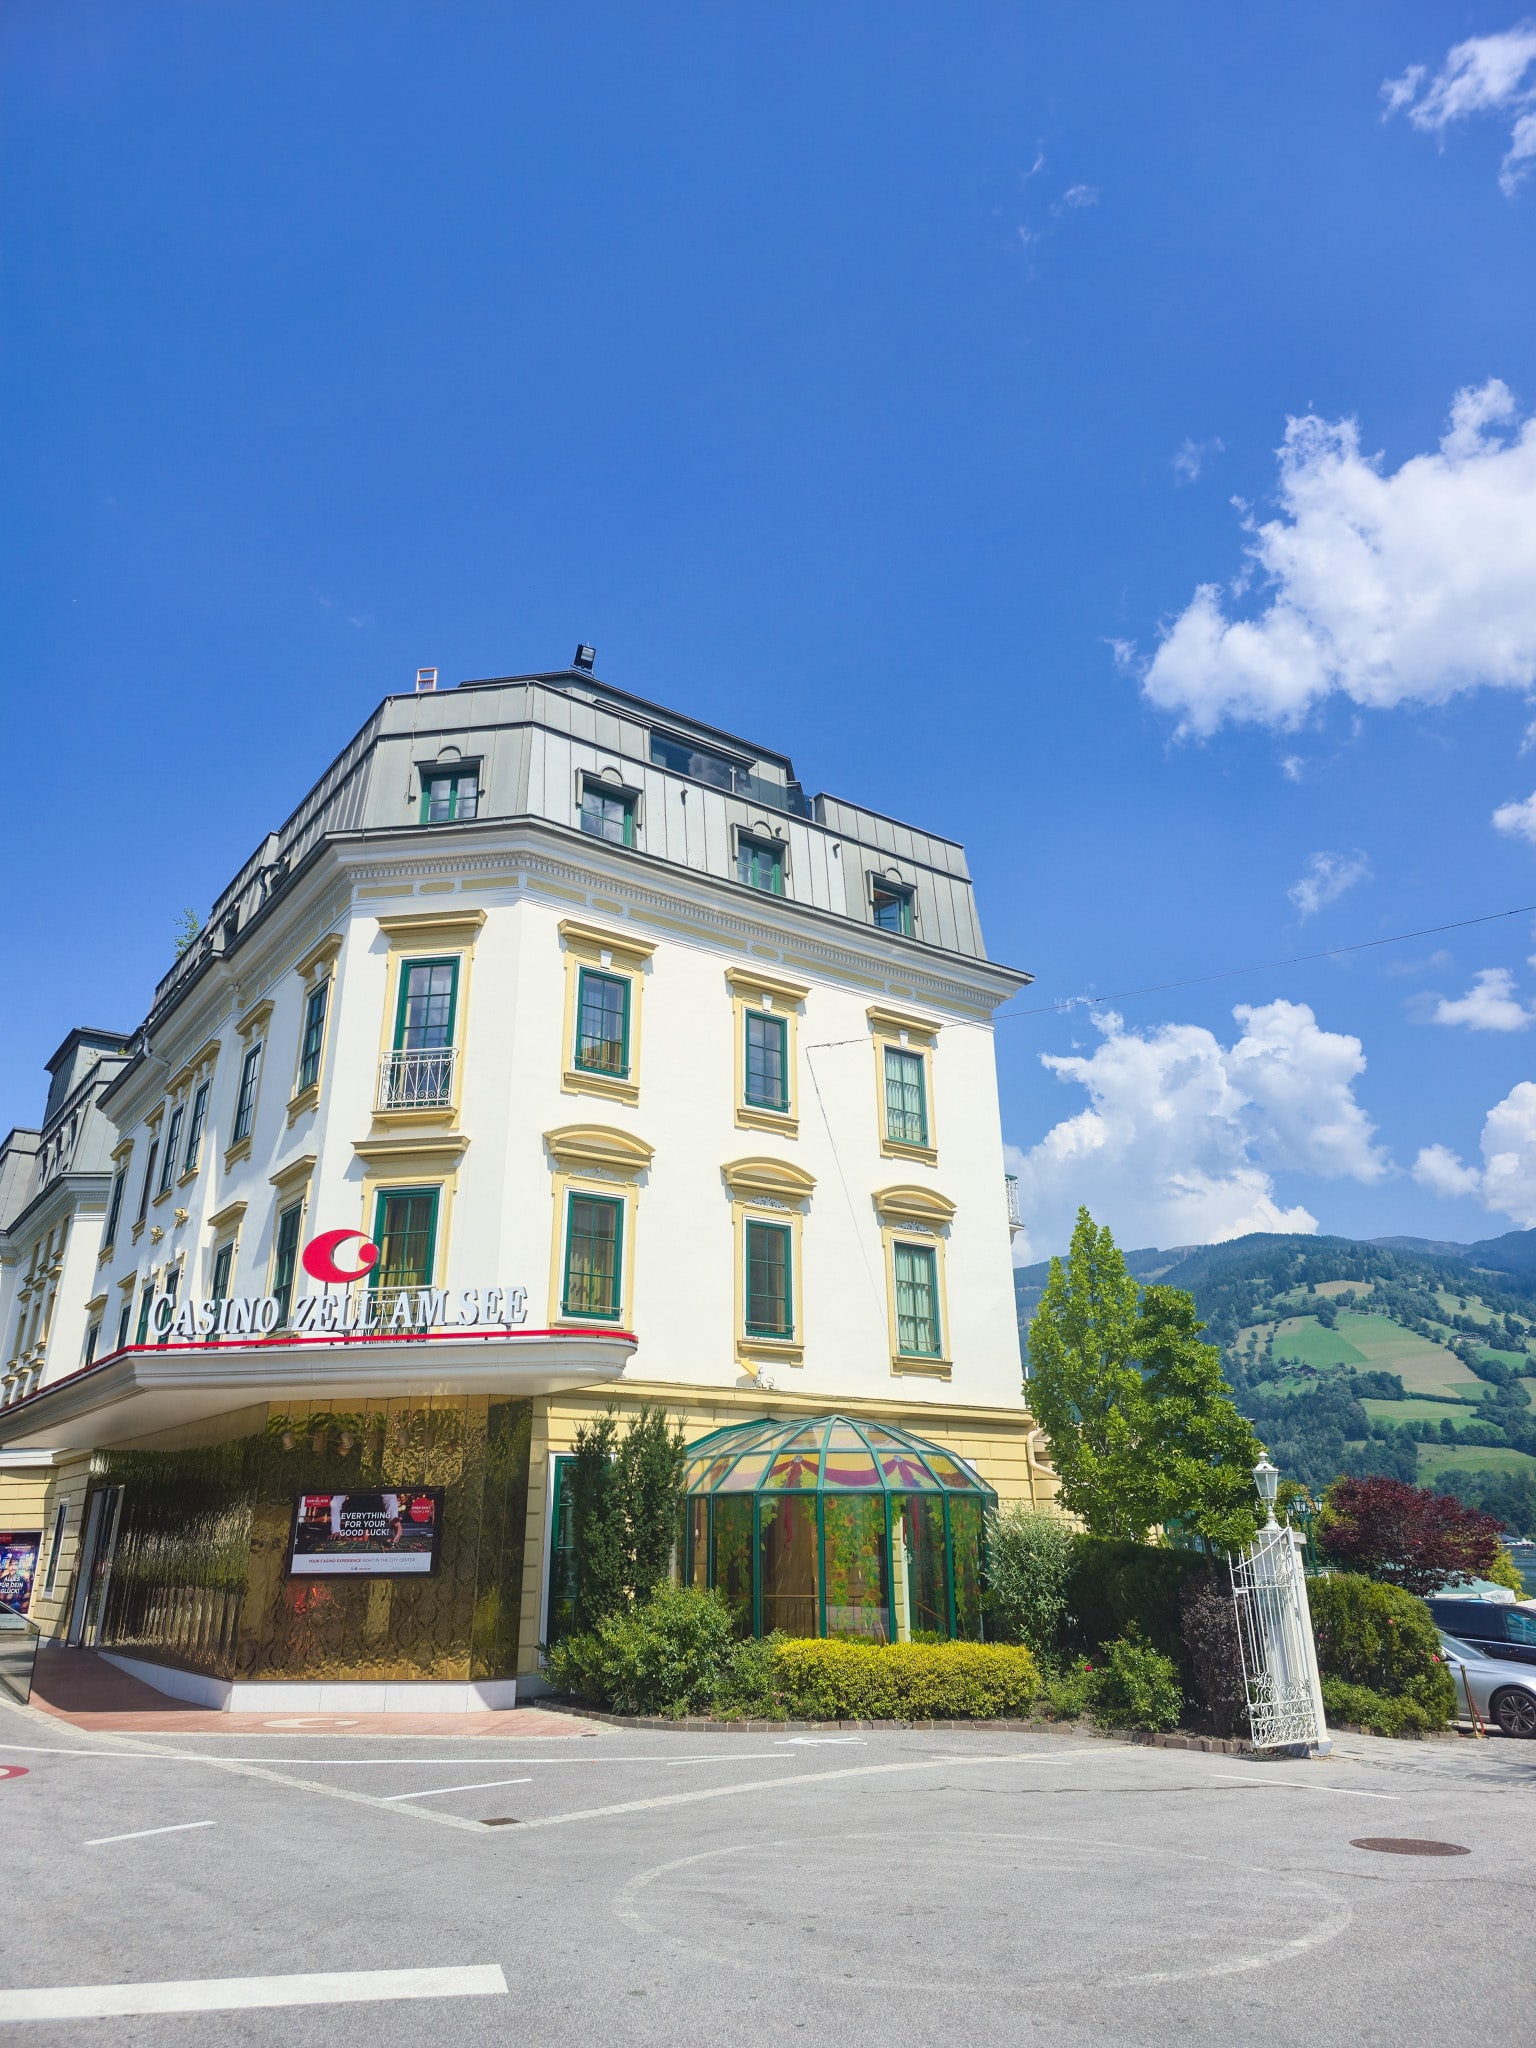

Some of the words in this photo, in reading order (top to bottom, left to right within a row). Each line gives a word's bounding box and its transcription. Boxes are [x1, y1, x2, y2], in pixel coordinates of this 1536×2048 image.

[148, 1294, 280, 1336] CASINO
[292, 1292, 380, 1331] ZELL
[387, 1290, 448, 1328] AM
[458, 1287, 527, 1326] SEE
[341, 1512, 391, 1520] EVERYTHING
[345, 1520, 361, 1528] FOR
[363, 1520, 386, 1528] YOUR
[340, 1529, 363, 1537] GOOD
